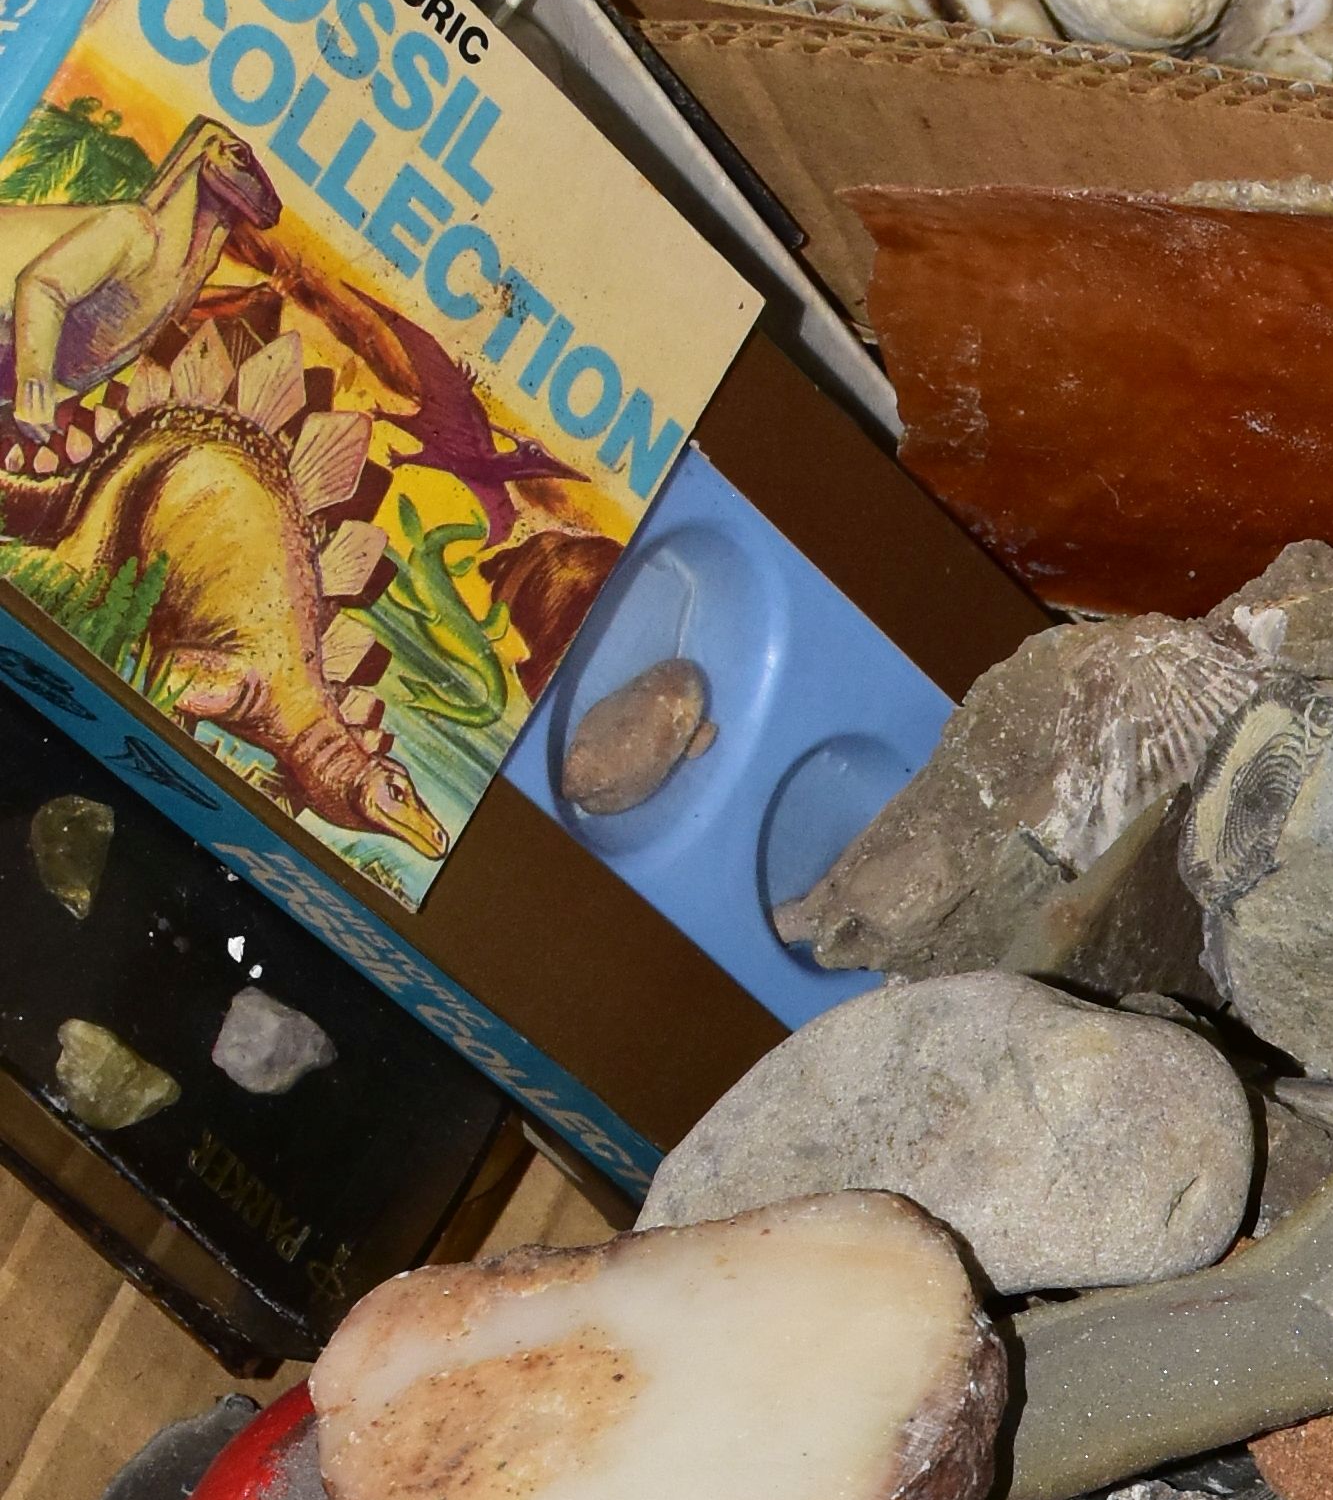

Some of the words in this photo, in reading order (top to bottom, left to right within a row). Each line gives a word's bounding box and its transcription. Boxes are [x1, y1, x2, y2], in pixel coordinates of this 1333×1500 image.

[211, 841, 415, 994] FOSSIL
[262, 851, 493, 1030] PREHISTORIC
[188, 1129, 311, 1263] PARKER
